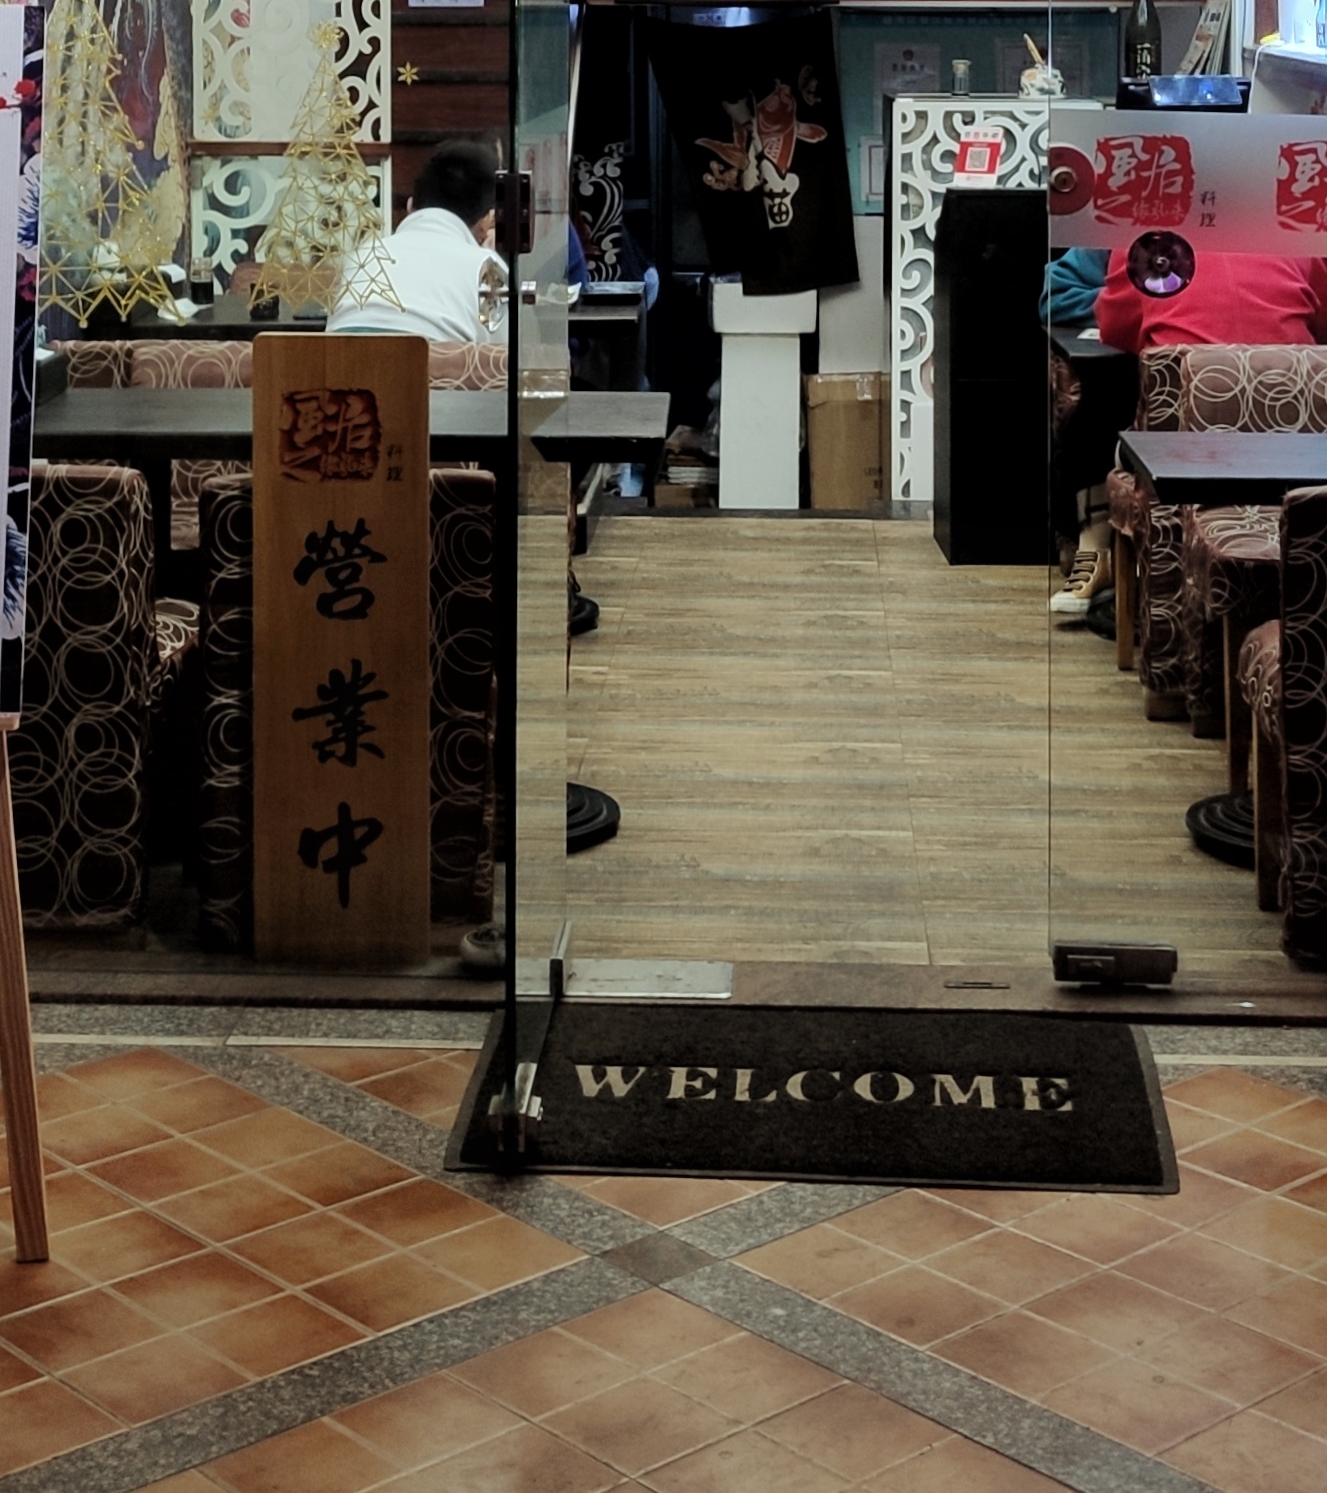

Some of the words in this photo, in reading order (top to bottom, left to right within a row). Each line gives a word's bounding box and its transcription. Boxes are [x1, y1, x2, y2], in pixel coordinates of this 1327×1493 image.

[291, 517, 389, 909] 營業中
[572, 1063, 1074, 1112] WELCOME
